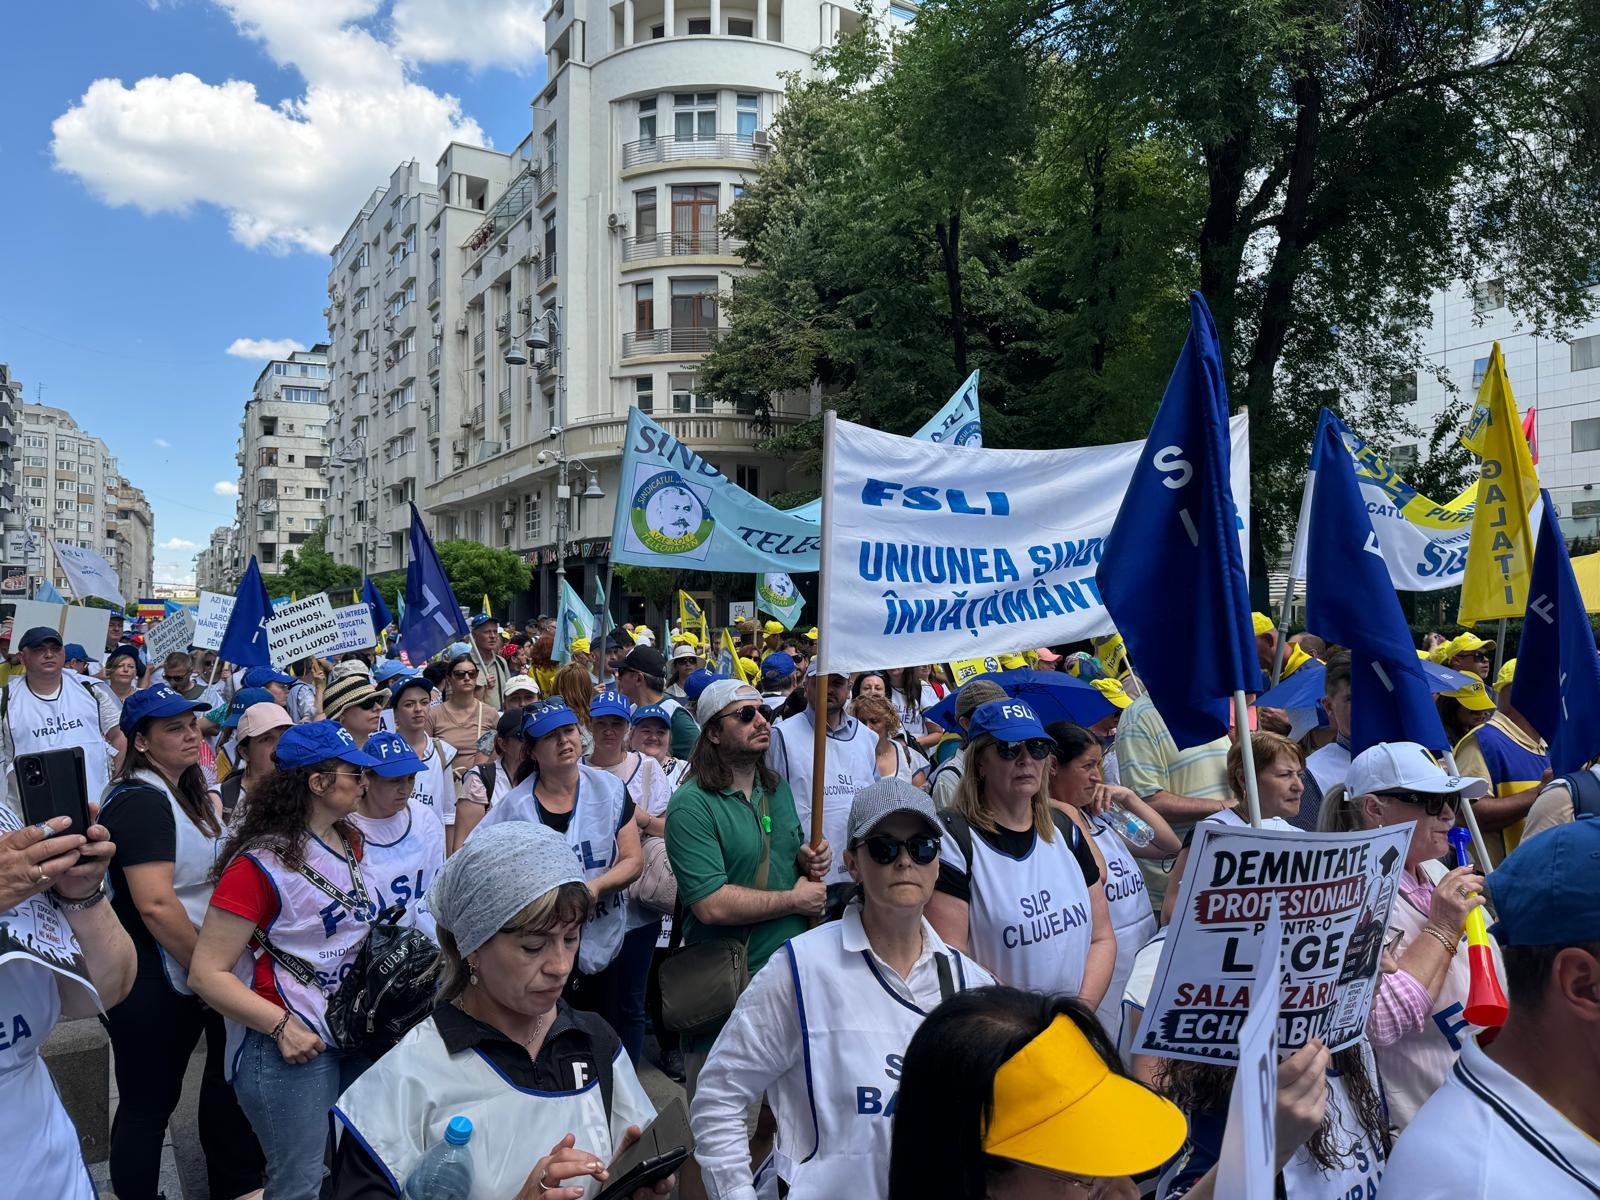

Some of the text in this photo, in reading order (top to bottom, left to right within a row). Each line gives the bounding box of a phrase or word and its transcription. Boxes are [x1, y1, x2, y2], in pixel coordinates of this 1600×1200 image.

[634, 425, 727, 484] SIND
[1154, 445, 1193, 489] S
[638, 475, 674, 504] SINDICATUL
[861, 478, 1010, 517] FSLI
[1367, 501, 1410, 520] CATU
[859, 540, 1020, 585] UNIUNEA
[269, 637, 288, 650] NOI
[286, 647, 304, 658] VOI
[598, 691, 627, 708] FSLI
[32, 718, 84, 738] VRANCEA
[838, 774, 853, 785] SLI
[1209, 843, 1371, 888] DEMNITATE
[1020, 890, 1050, 918] SLIP
[1207, 876, 1363, 920] PROFESIONALĂ
[1002, 902, 1088, 949] CLUJEAN
[281, 953, 304, 975] GUESS
[379, 944, 409, 975] GUESS
[1281, 972, 1292, 985] A
[1174, 979, 1340, 1009] SALAZĂRII
